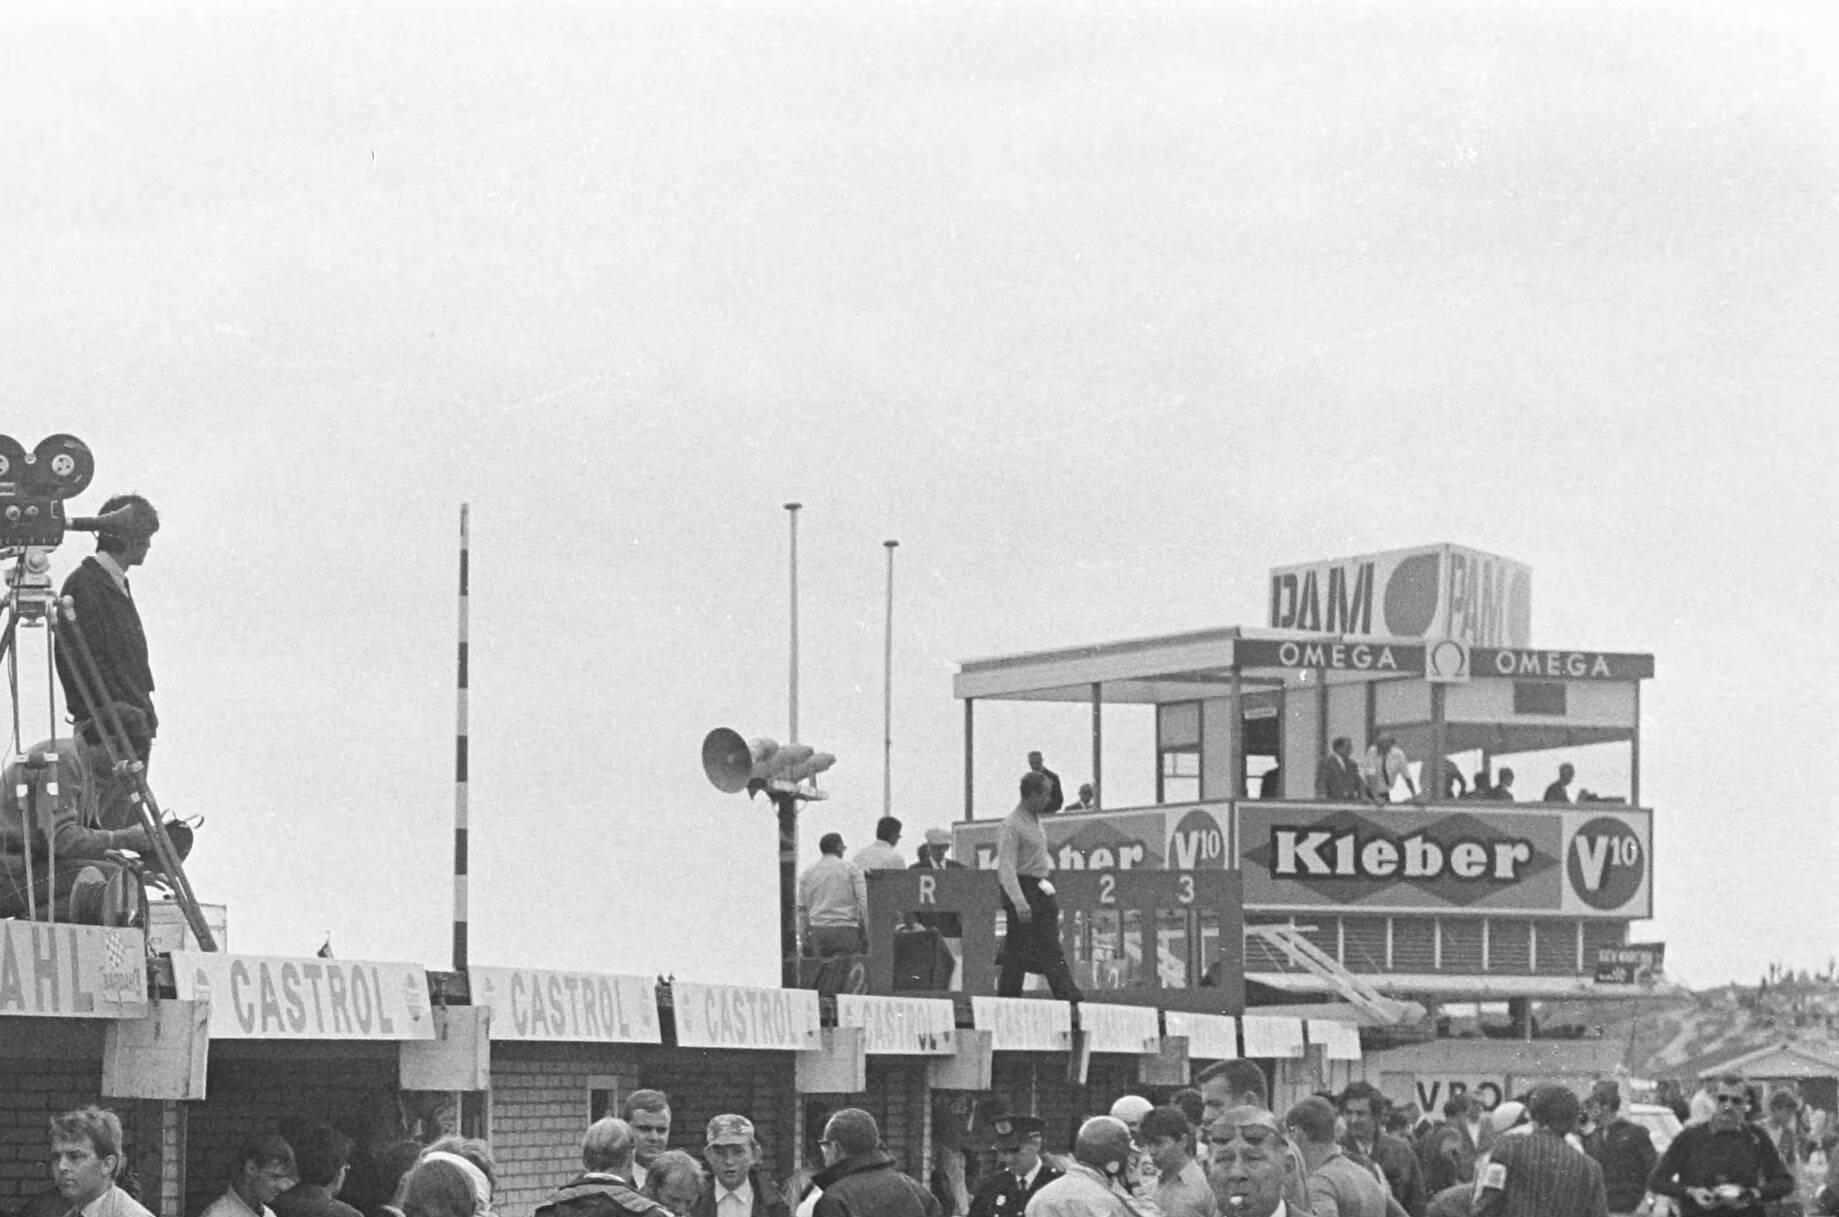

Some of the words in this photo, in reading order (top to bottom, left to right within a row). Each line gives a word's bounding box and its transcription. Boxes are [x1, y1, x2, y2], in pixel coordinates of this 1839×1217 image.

[1279, 642, 1397, 669] OMEGA
[1495, 652, 1612, 677] OMEGA
[1275, 830, 1531, 879] Kleber
[919, 875, 935, 905] R
[1099, 874, 1116, 904] 2
[1178, 875, 1195, 904] 3
[230, 959, 395, 1035] CASTROL
[511, 972, 631, 1038] CASTROL
[704, 987, 799, 1045] CASTROL
